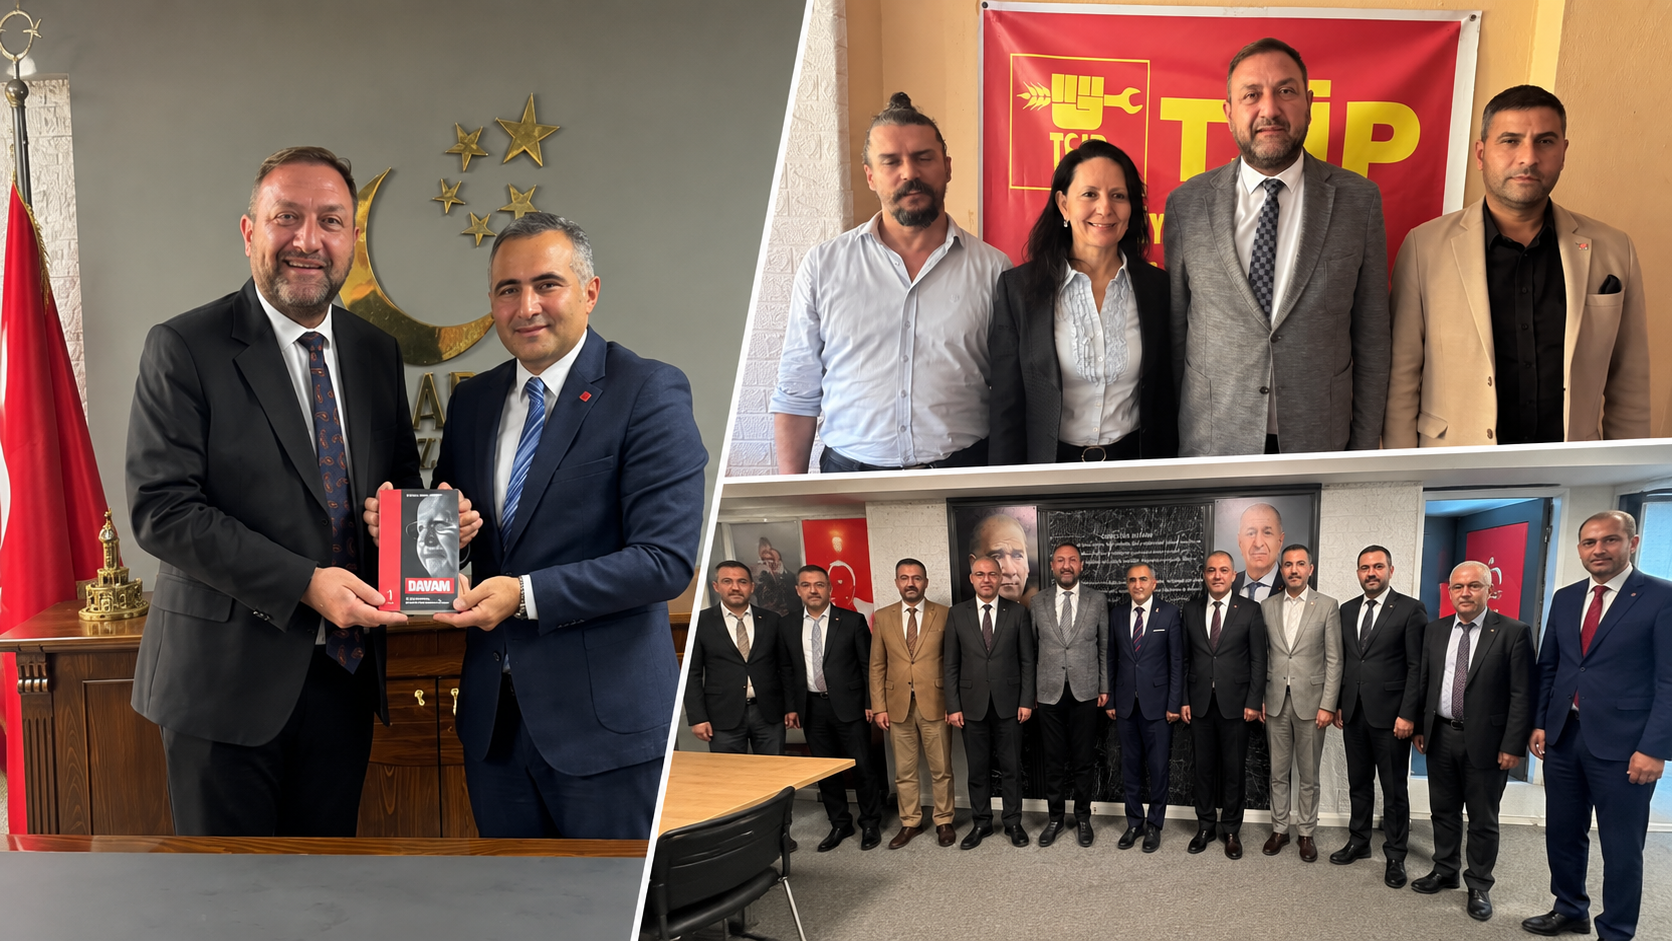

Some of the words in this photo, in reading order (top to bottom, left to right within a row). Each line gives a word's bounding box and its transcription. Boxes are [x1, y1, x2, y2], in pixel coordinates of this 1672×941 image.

[1160, 80, 1421, 181] TİP
[408, 580, 451, 592] DAVAM
[387, 589, 393, 601] 1
